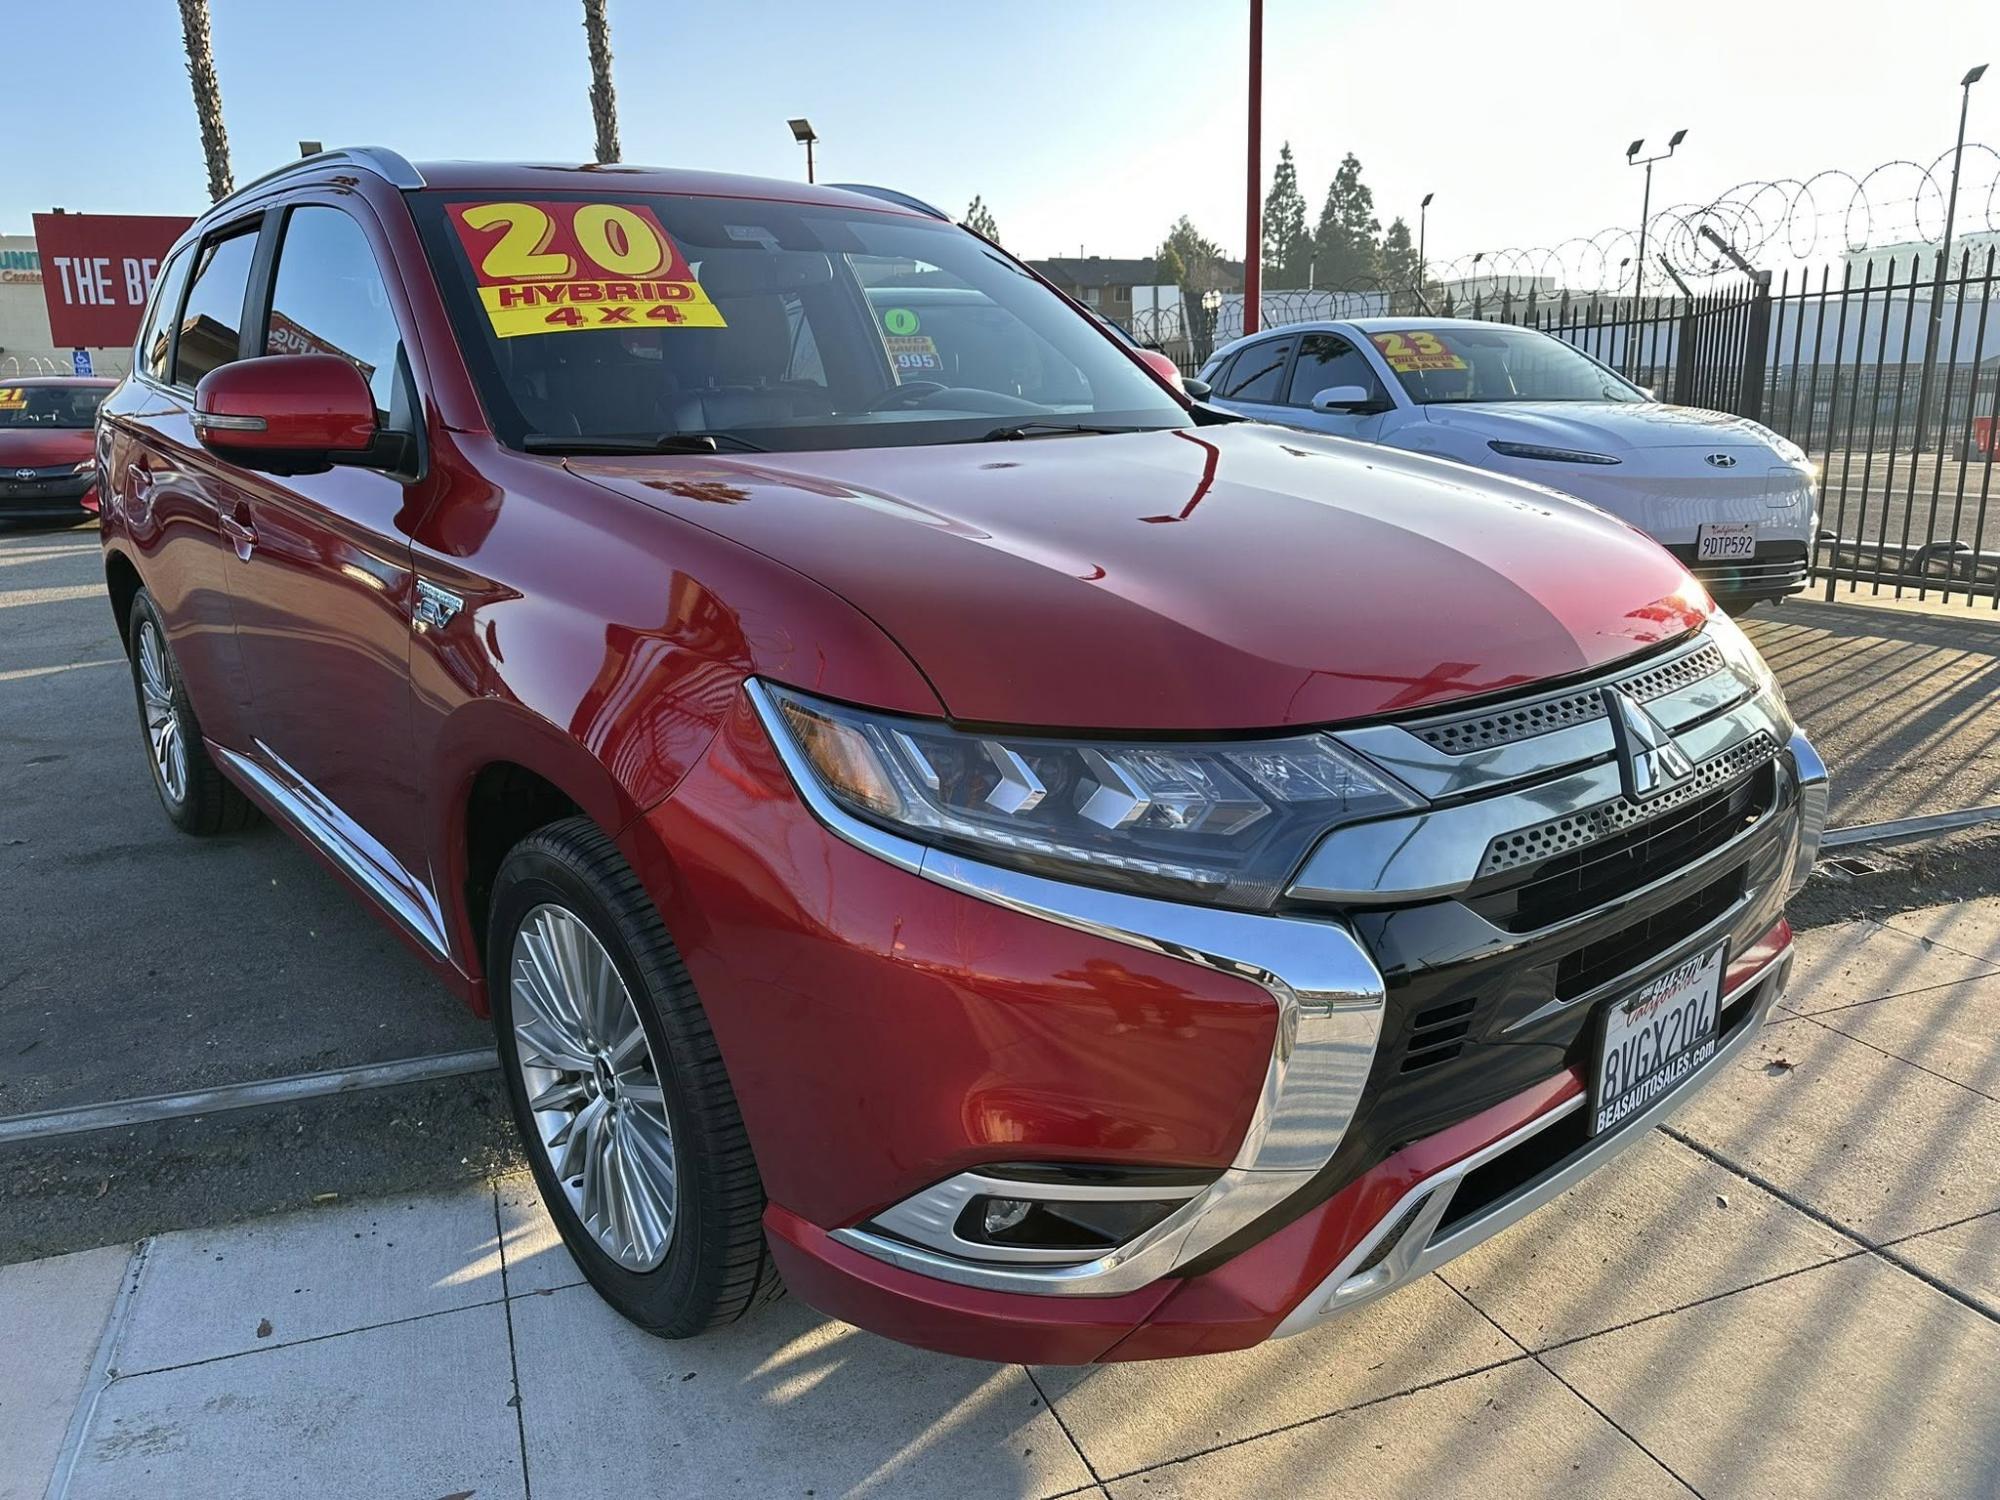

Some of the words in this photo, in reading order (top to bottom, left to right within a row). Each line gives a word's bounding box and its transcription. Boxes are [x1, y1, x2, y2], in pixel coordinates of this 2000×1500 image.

[462, 203, 672, 281] 20
[53, 257, 115, 305] THE
[499, 283, 695, 308] HYBRID
[1374, 332, 1444, 356] 23
[1703, 536, 1753, 555] 9DTP592
[1602, 990, 1709, 1106] 8VGX204
[1596, 1039, 1715, 1134] BEASAUTOSALES.com
